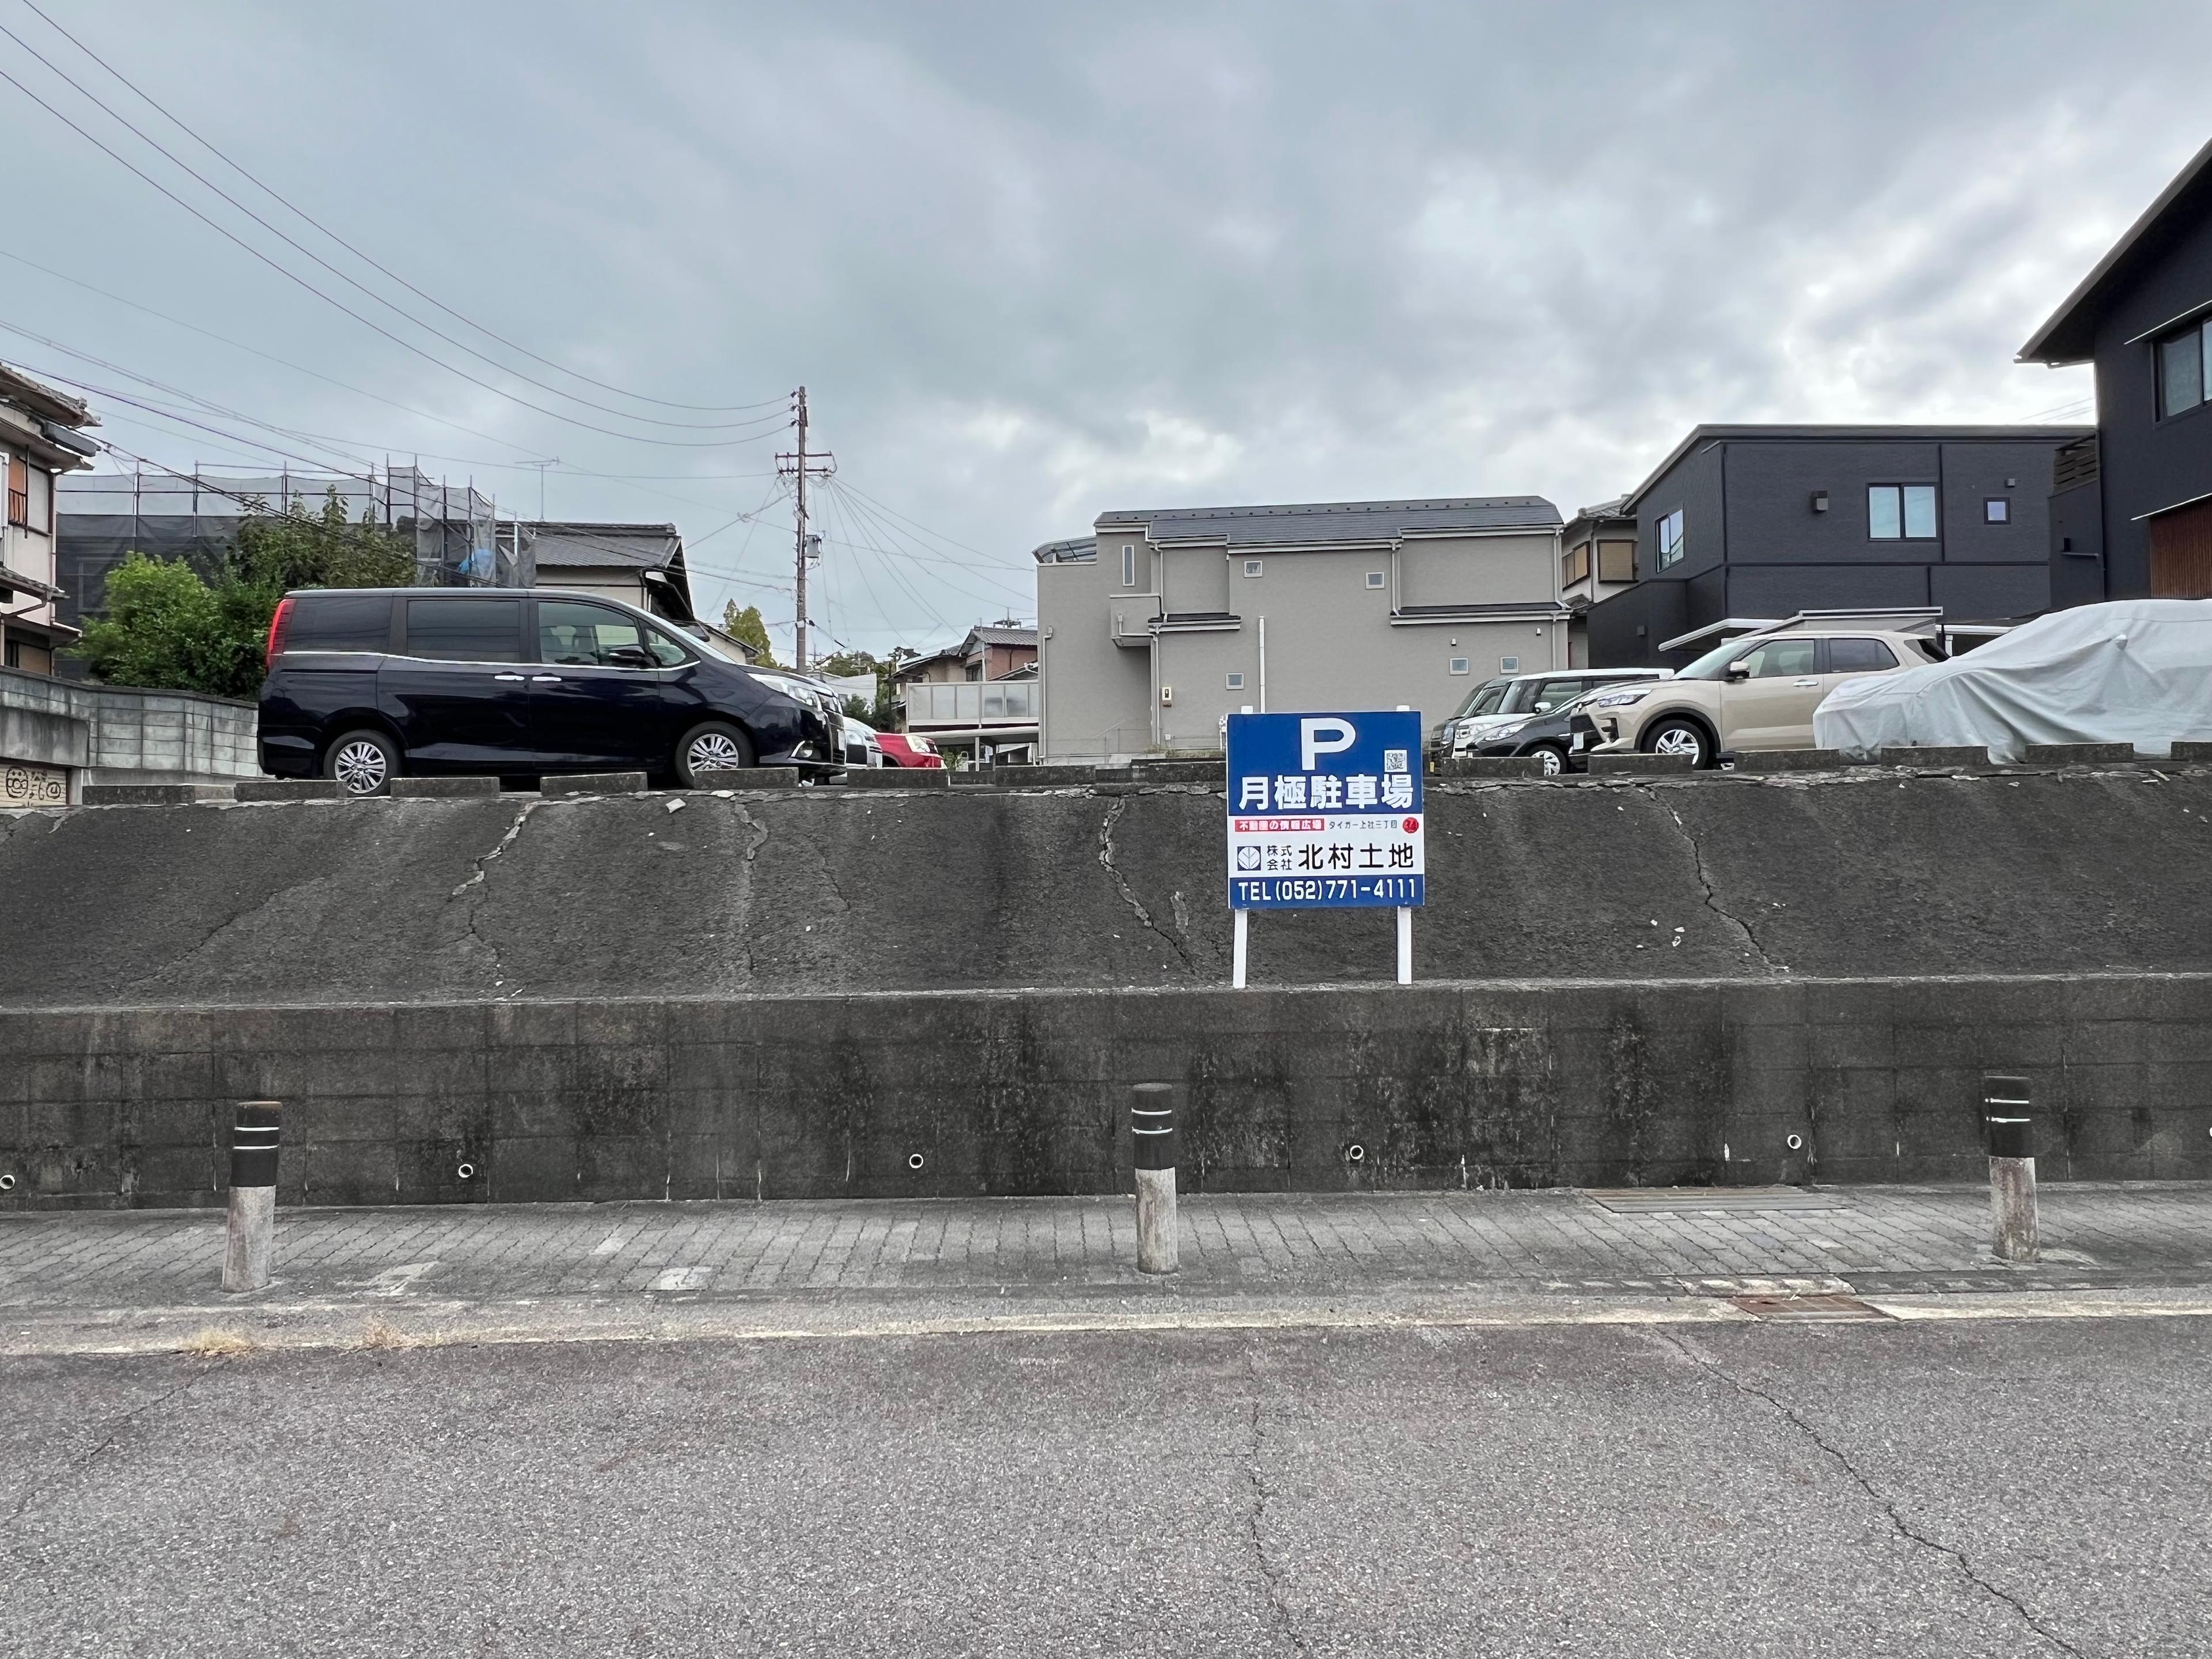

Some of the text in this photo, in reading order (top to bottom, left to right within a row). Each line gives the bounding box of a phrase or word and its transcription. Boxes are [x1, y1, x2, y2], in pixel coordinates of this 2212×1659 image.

[1301, 718, 1356, 771] P
[1239, 774, 1414, 810] 月極駐車場
[1298, 843, 1414, 870] 北村土地
